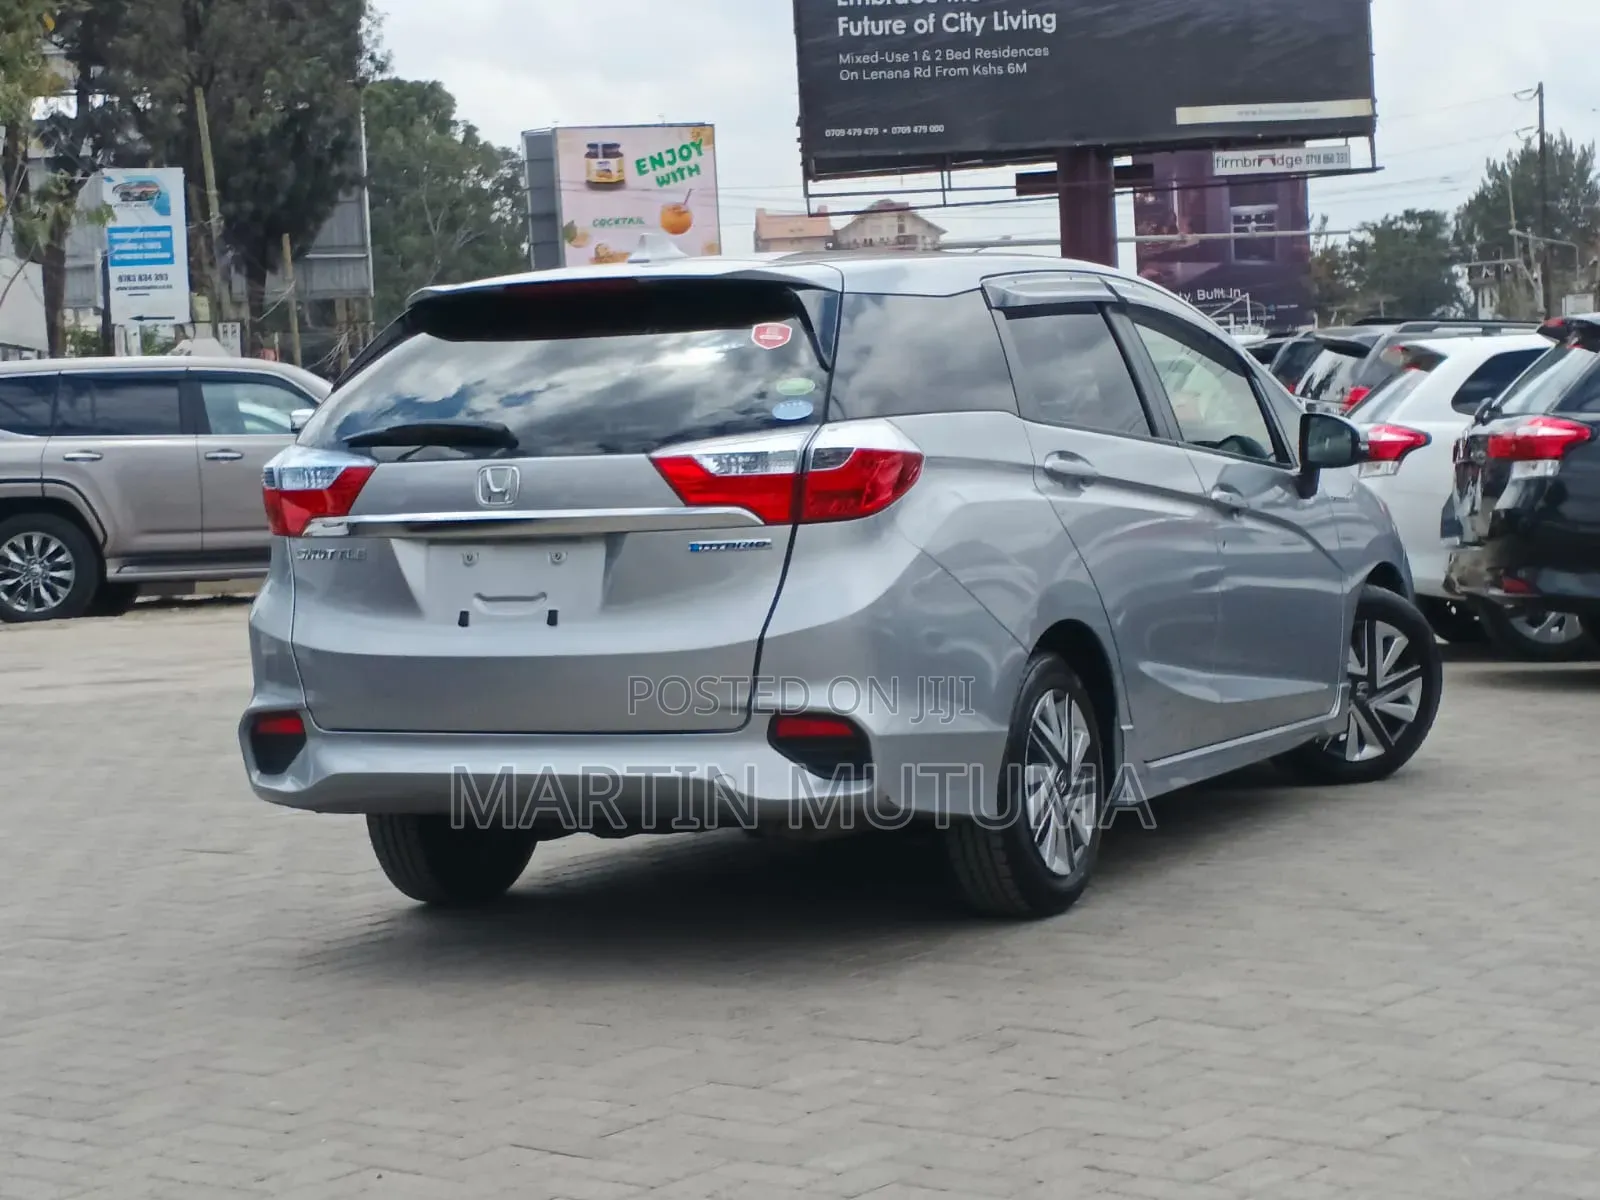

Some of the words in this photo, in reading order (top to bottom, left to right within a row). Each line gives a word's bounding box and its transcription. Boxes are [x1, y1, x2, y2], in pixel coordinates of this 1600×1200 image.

[838, 16, 906, 37] Future
[914, 13, 935, 34] of
[942, 12, 986, 37] City
[993, 9, 1057, 33] Living
[839, 51, 910, 65] Mixed-Use
[913, 51, 919, 62] 1
[922, 50, 931, 61] &
[935, 49, 942, 61] 2
[946, 48, 971, 60] Bed
[975, 46, 1049, 59] Residences
[839, 69, 859, 81] On
[863, 69, 910, 80] Lenana
[914, 65, 931, 78] Rd
[935, 65, 969, 77] From
[973, 62, 1004, 76] Kshs
[1007, 62, 1027, 74] 6M
[635, 138, 705, 177] ENJOY
[655, 164, 701, 188] WITH
[592, 216, 645, 228] COCKTAIL
